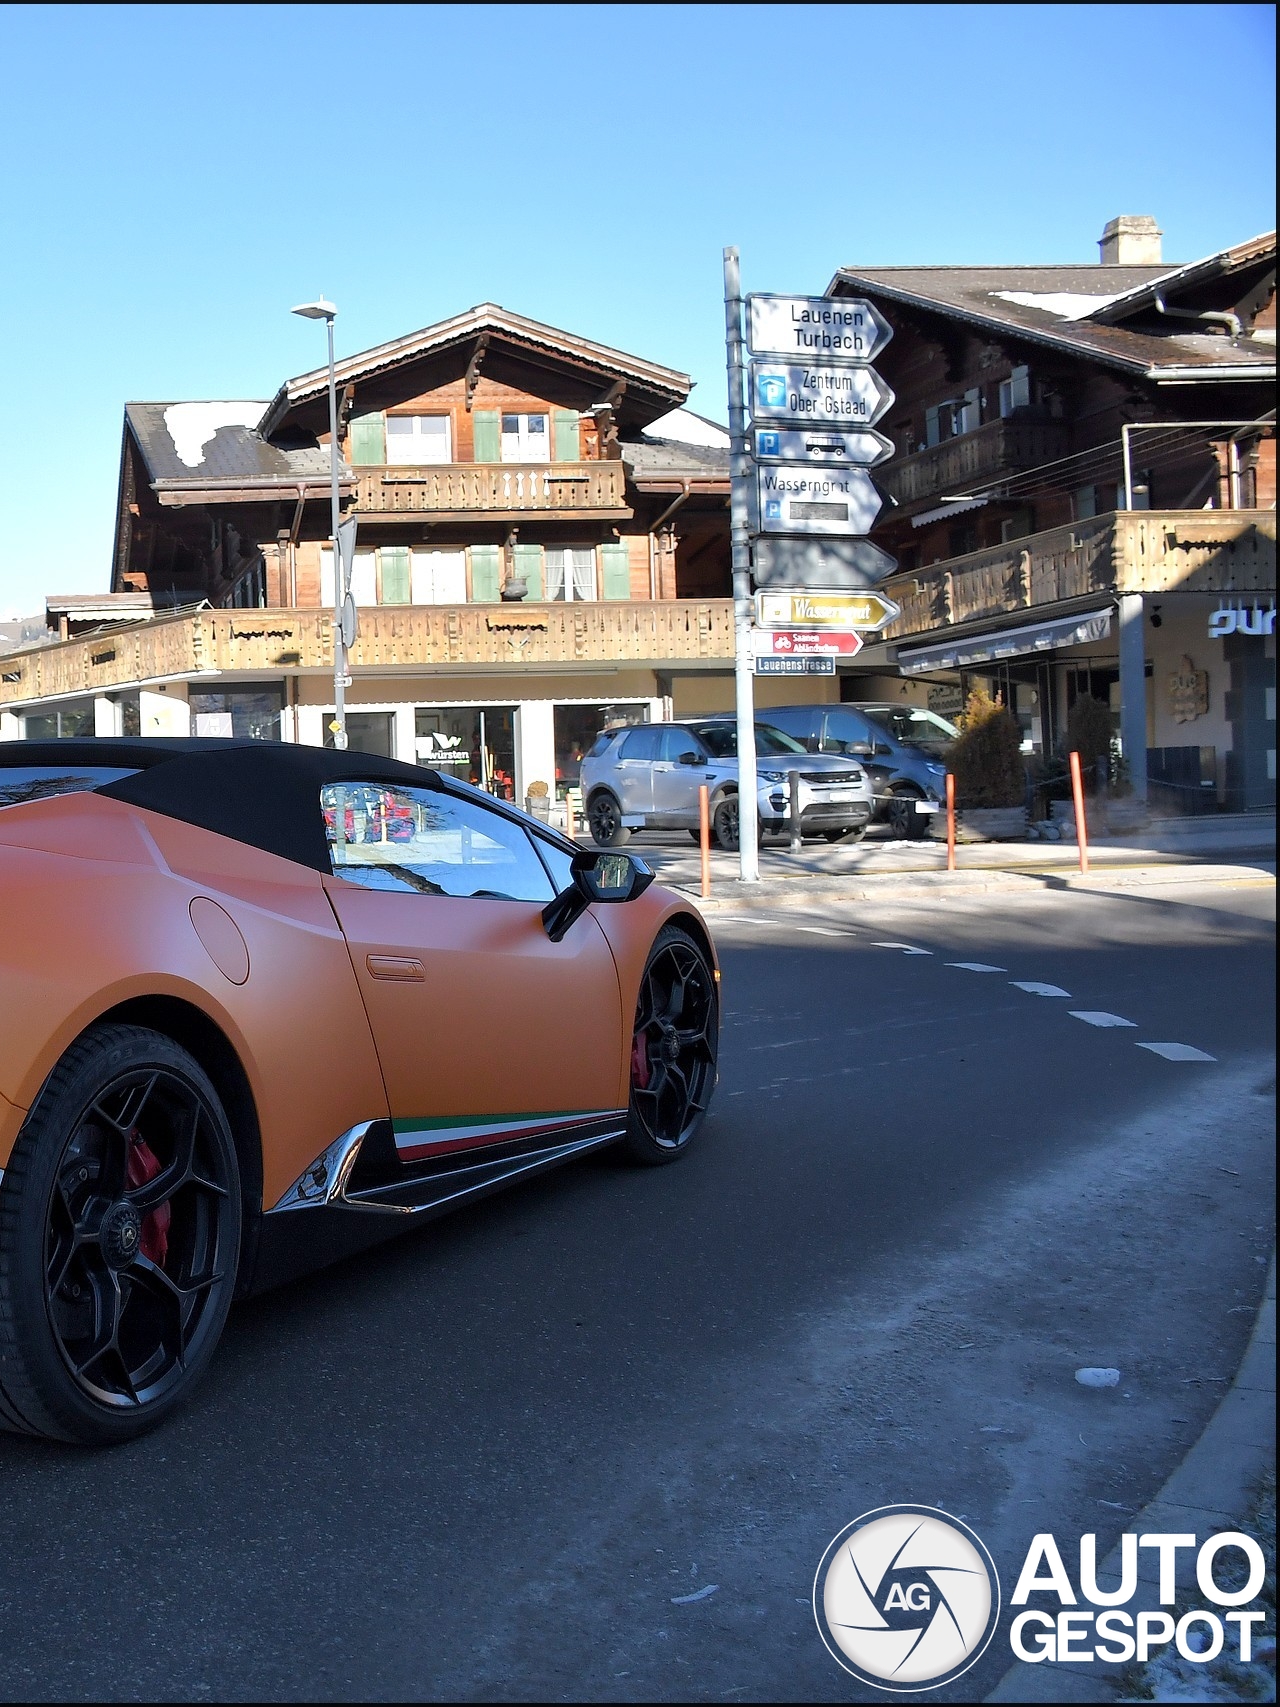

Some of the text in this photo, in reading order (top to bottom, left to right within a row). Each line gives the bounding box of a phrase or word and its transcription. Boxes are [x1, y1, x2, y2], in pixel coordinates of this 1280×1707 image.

[791, 305, 863, 326] Lauenen
[794, 329, 863, 350] Turbach
[802, 370, 853, 391] Zentrum
[758, 658, 832, 671] Lauenenstrasse
